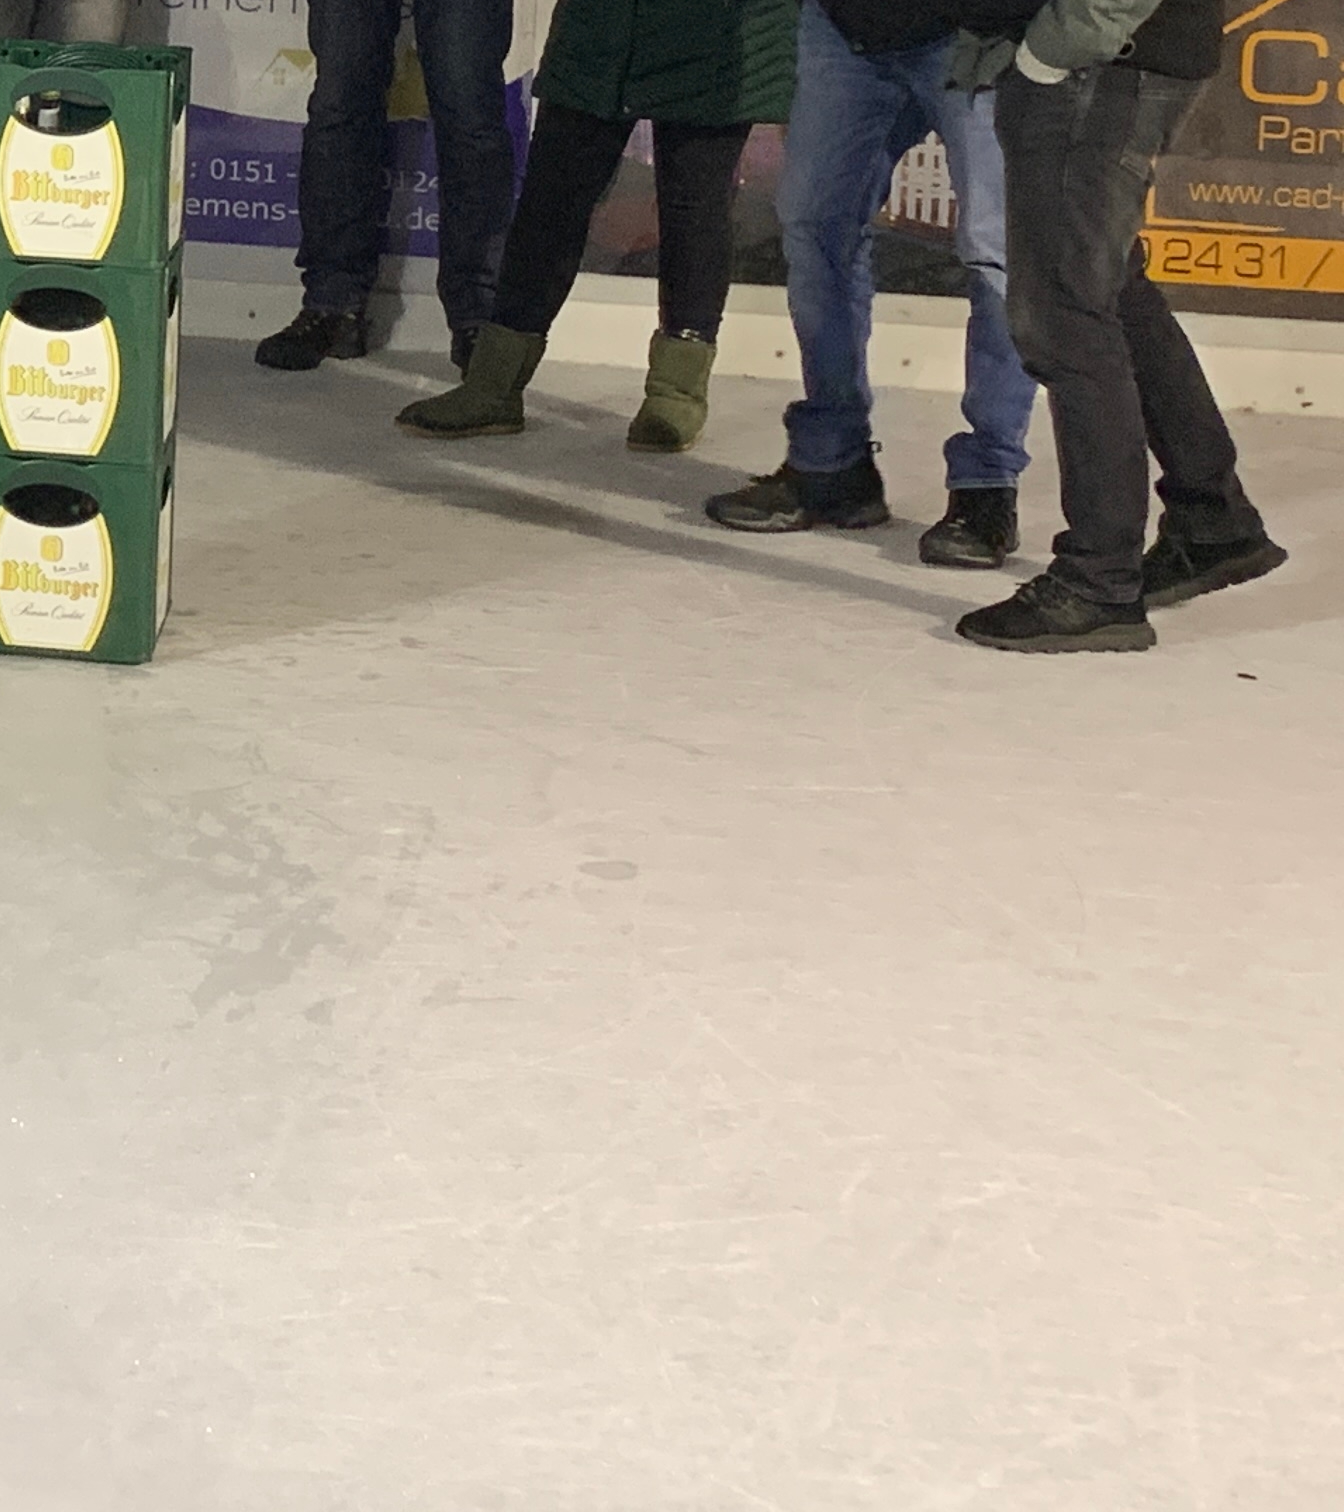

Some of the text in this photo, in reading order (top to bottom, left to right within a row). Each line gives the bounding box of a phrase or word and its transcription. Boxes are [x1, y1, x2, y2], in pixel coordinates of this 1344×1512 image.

[1240, 29, 1344, 106] C
[1256, 114, 1344, 156] Par
[9, 169, 111, 210] Bitburger
[210, 158, 277, 184] 0151
[185, 194, 300, 222] emens-
[1188, 182, 1344, 214] www.cad-
[6, 364, 107, 406] Bitburger
[0, 559, 100, 601] Bitburger
